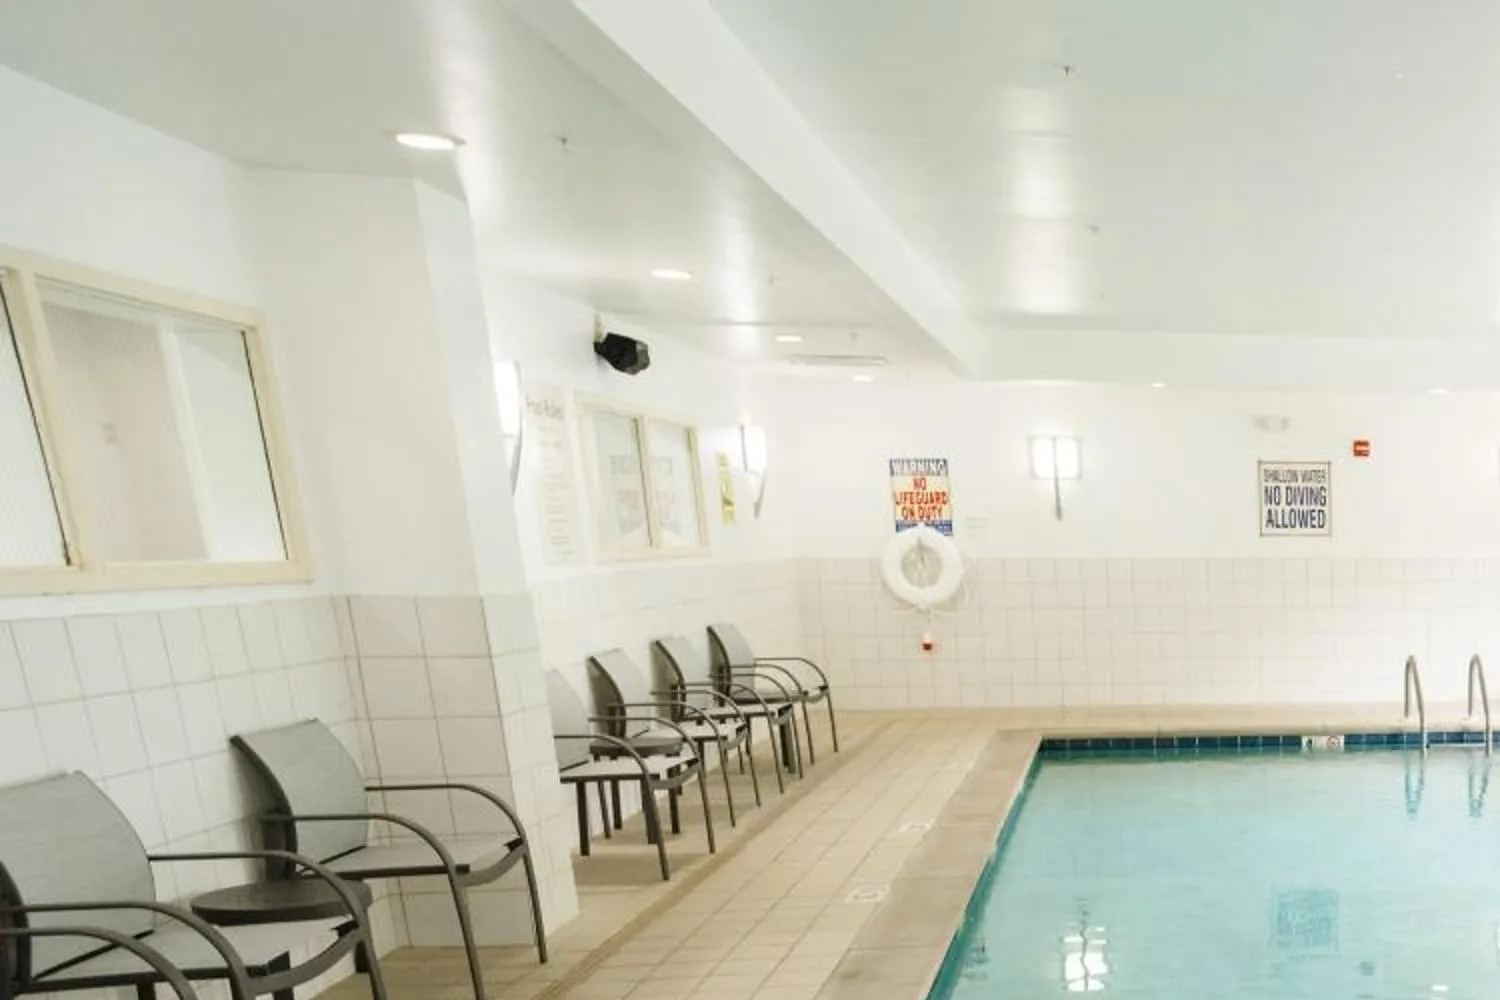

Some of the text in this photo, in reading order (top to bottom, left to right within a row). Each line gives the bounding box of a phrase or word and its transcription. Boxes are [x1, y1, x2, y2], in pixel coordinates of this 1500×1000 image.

[913, 477, 927, 490] NO
[895, 491, 949, 505] LIFEGUARD
[1264, 485, 1327, 506] NO DIVING
[902, 505, 942, 520] ON DUTY
[1265, 508, 1326, 529] ALLOWED
